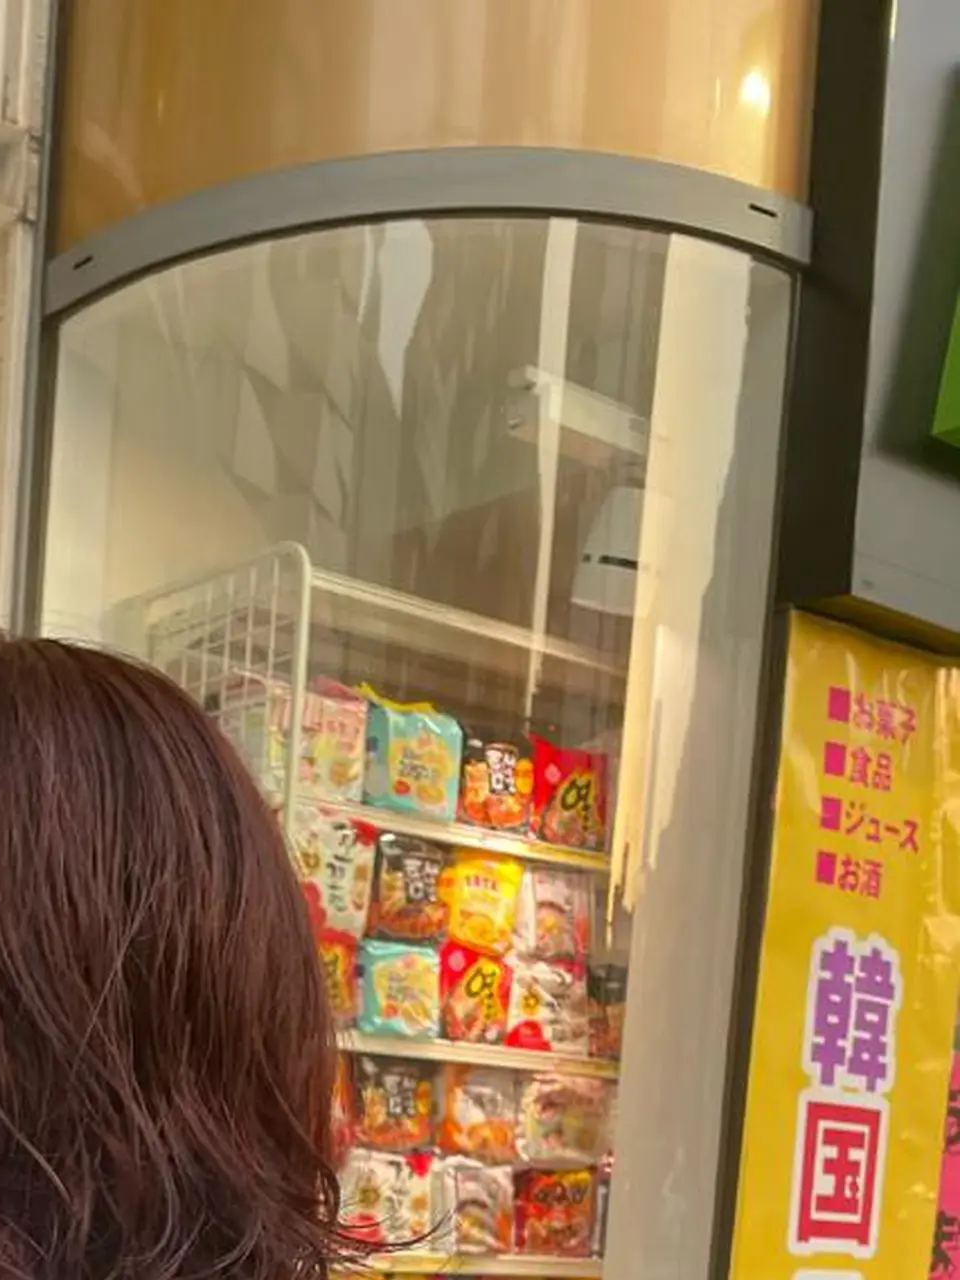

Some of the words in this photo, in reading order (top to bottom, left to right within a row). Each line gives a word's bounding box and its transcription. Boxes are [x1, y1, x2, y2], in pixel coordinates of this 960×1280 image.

[852, 691, 917, 745] お菓子
[850, 746, 892, 792] 食品
[845, 800, 920, 855] ジュース
[838, 853, 883, 899] お酒
